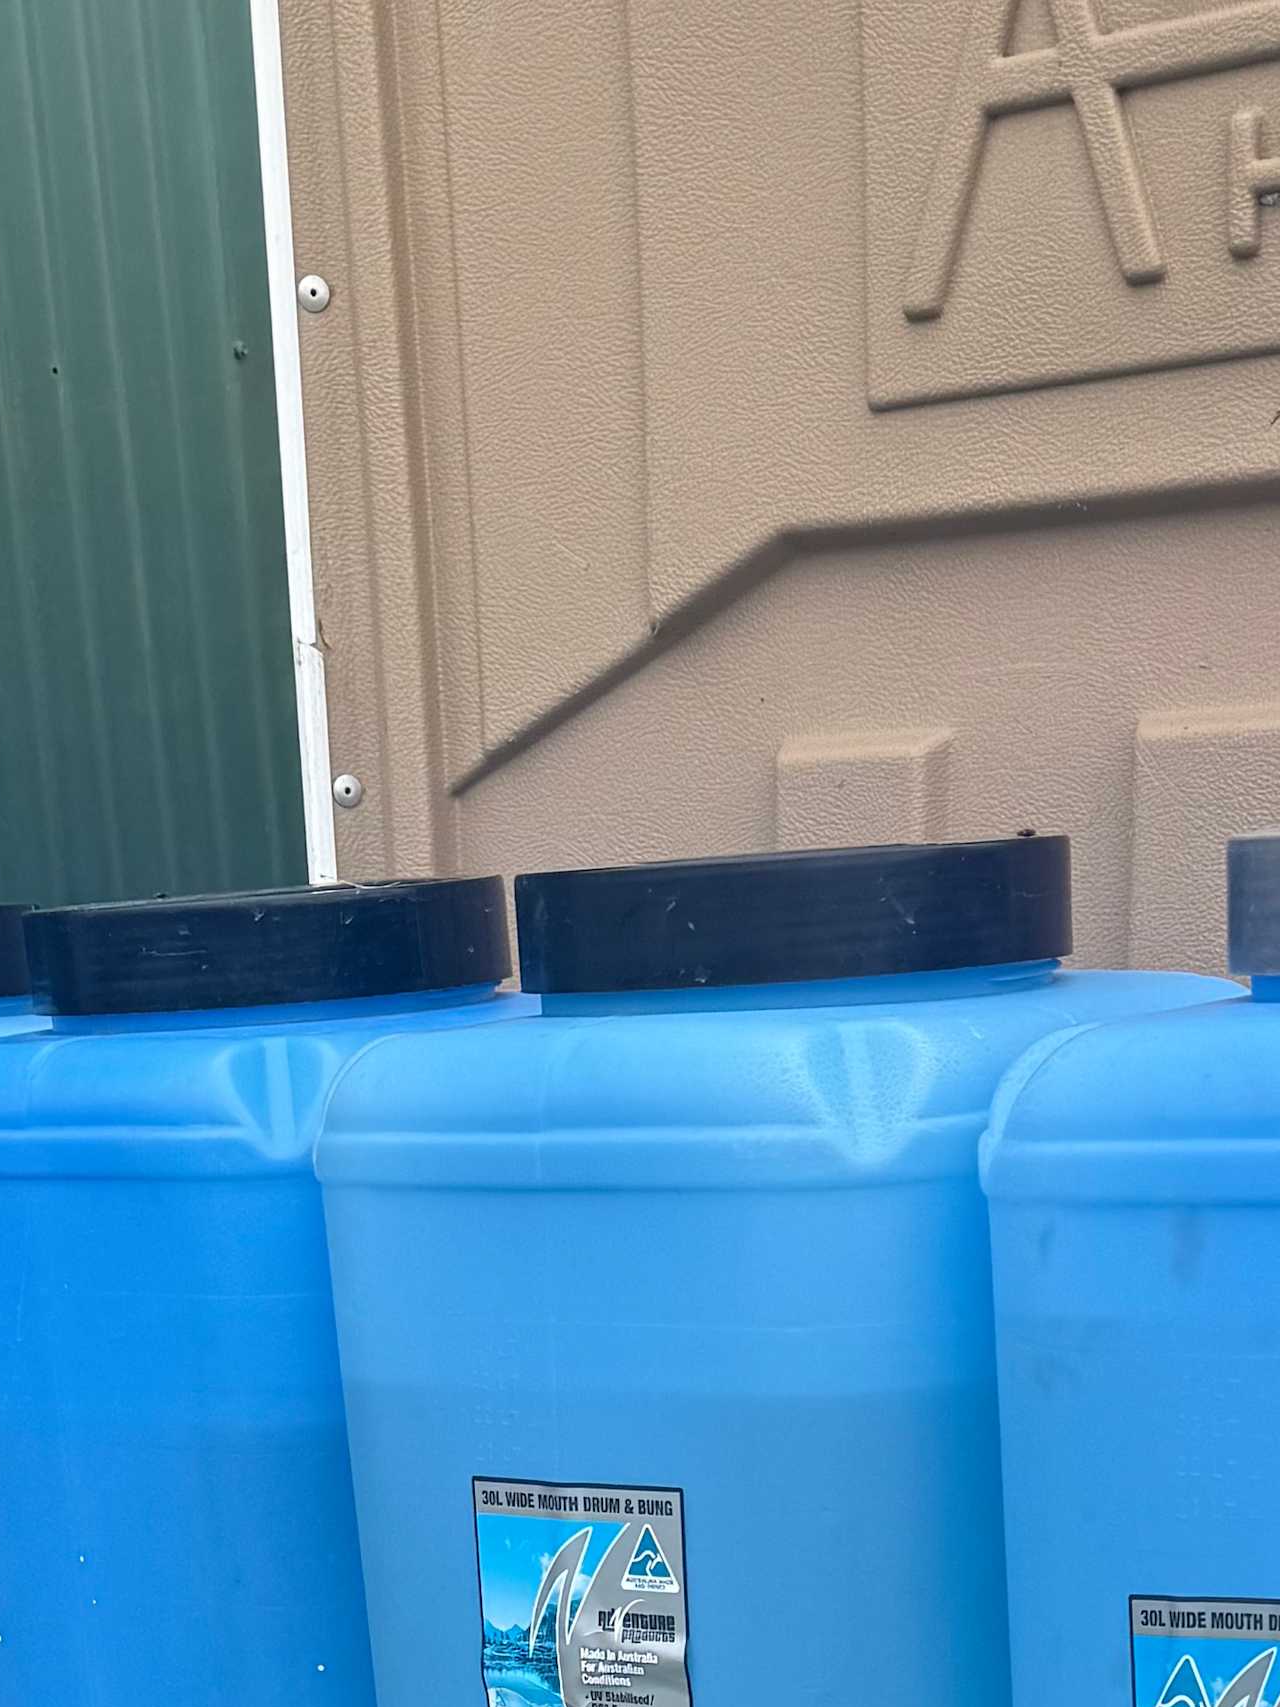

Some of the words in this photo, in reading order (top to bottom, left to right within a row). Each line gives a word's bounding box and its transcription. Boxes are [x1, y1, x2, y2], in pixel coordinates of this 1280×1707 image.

[482, 1491, 503, 1506] 30L
[505, 1492, 535, 1508] WIDE
[538, 1494, 578, 1511] MOUTH
[583, 1496, 620, 1513] DRUM
[625, 1499, 634, 1514] &
[638, 1499, 673, 1516] BUNG
[1141, 1610, 1165, 1627] 30L
[1170, 1611, 1206, 1628] WIDE
[1211, 1612, 1263, 1631] MOUTH
[618, 1651, 658, 1664] Australia
[581, 1661, 596, 1672] For
[581, 1673, 631, 1686] Conditions
